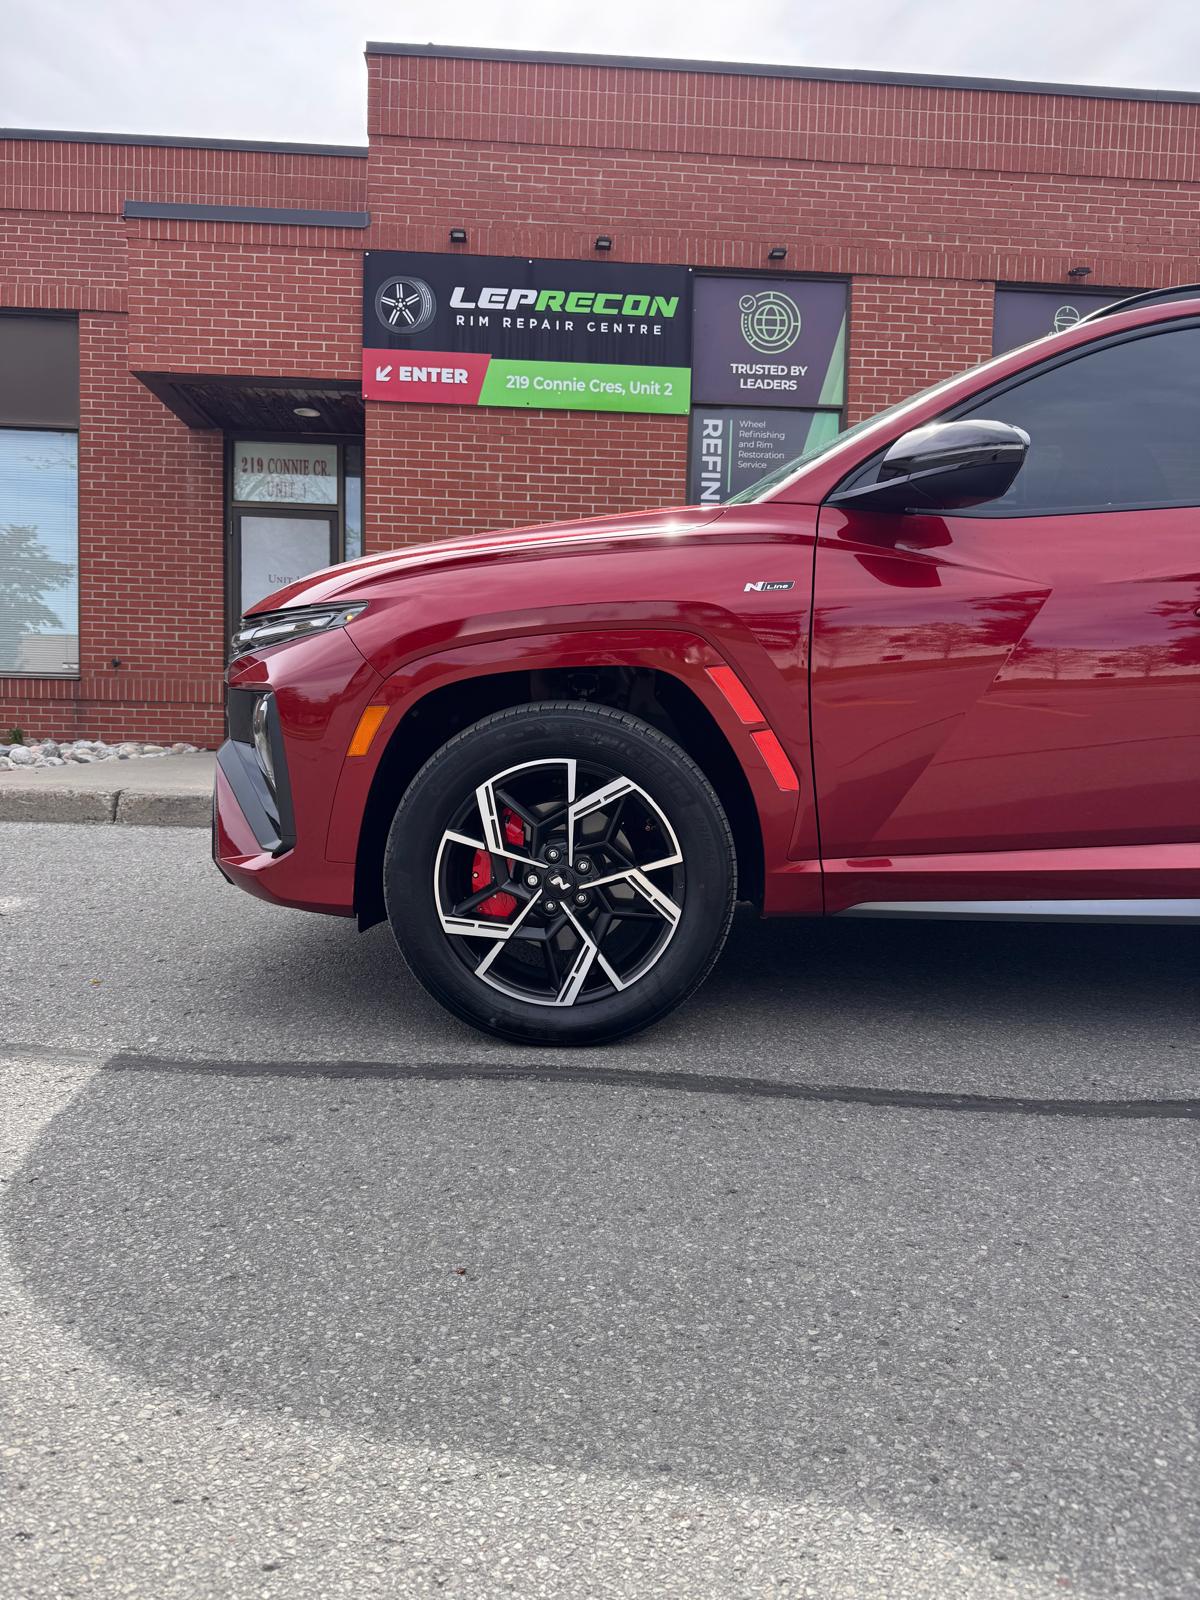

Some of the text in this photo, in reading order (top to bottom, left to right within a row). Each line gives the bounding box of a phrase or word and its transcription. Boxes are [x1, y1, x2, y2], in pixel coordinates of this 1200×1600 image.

[450, 286, 680, 318] LEPRECON
[456, 315, 662, 335] RIM REPAIR CENTRE
[399, 366, 468, 384] ENTER
[730, 363, 808, 376] TRUSTED BY
[506, 375, 673, 396] 219 Connie Cres, Unit 2
[740, 378, 798, 391] LEADERS
[739, 420, 766, 429] Wheel
[739, 430, 786, 440] Refinishing
[738, 440, 773, 449] and Rim
[738, 451, 785, 460] Restoration
[241, 457, 264, 473] 219
[267, 458, 310, 475] CONNIE
[737, 460, 767, 469] Service
[267, 481, 295, 498] UNIT
